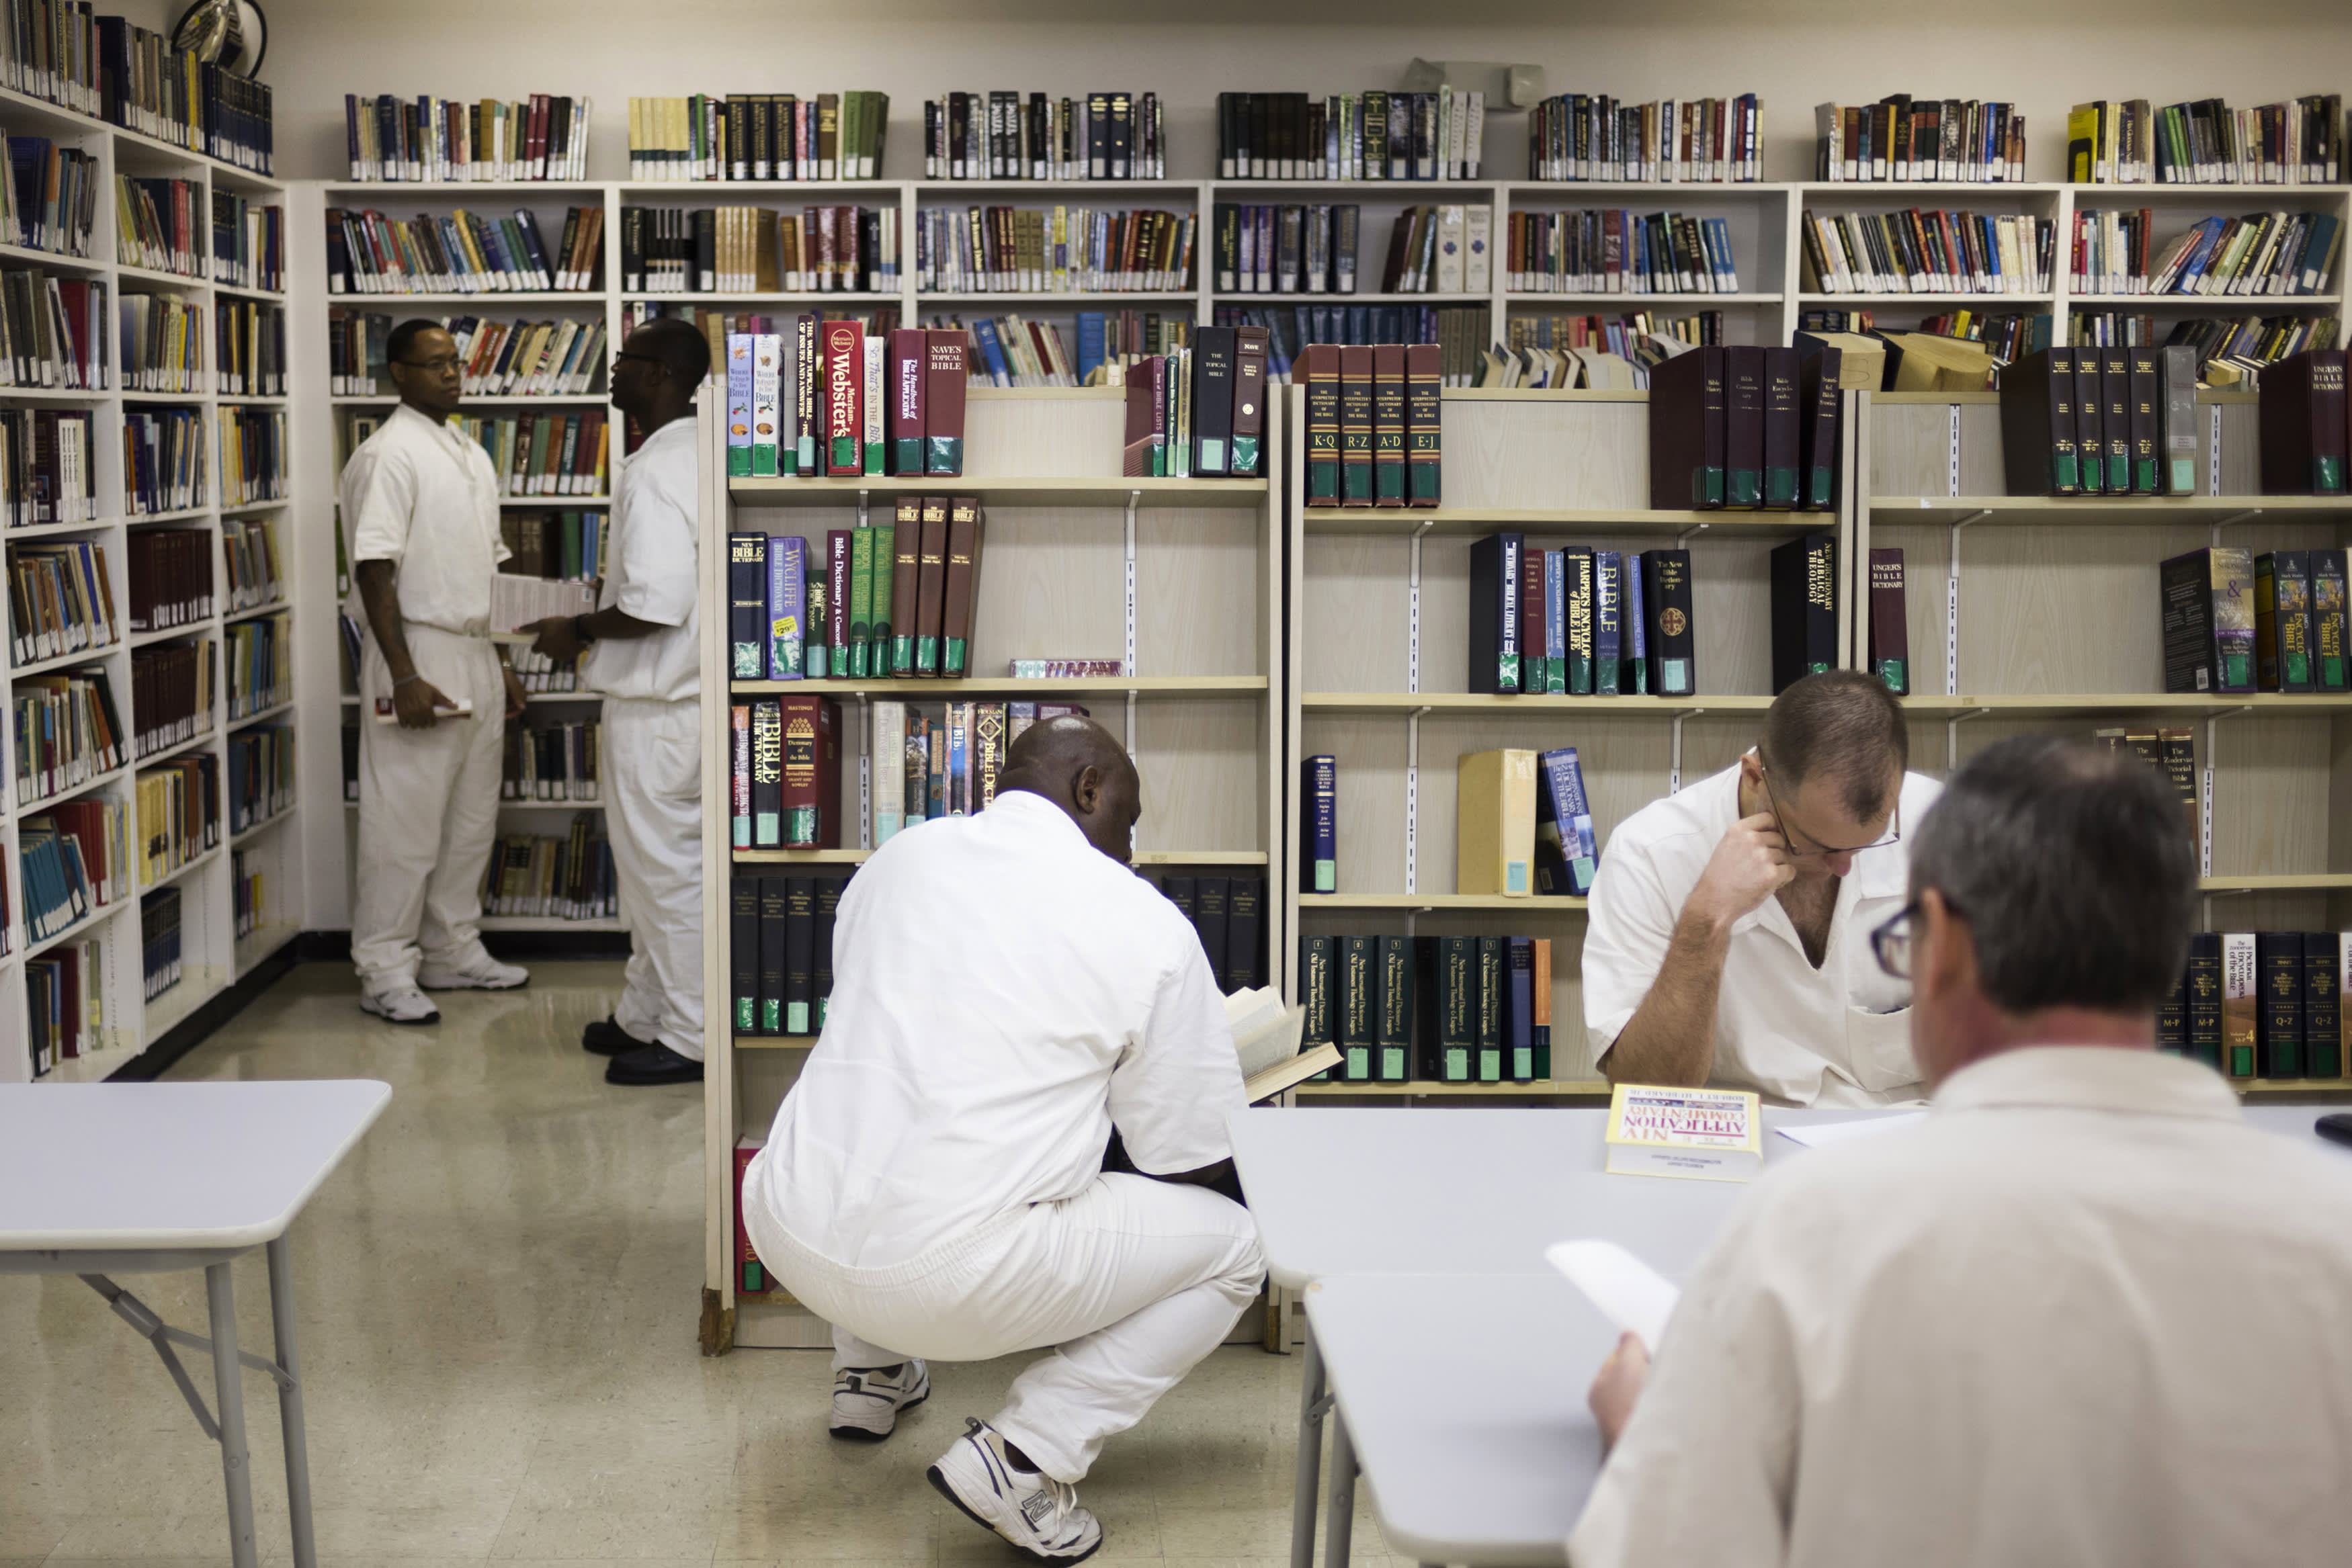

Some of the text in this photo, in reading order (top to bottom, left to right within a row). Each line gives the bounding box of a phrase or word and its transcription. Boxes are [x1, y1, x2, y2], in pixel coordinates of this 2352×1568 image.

[798, 322, 806, 333] OF
[931, 345, 962, 354] NAVE'S
[869, 362, 880, 393] That's
[931, 362, 962, 370] BIBLE
[2313, 365, 2343, 373] UNGER'S
[2314, 374, 2343, 382] BIBLE
[729, 387, 751, 398] BIBLE
[755, 392, 776, 402] BIBLE
[832, 353, 851, 437] Webster's
[870, 395, 877, 403] IN
[902, 359, 910, 419] BIBLE APPLICATION
[909, 359, 918, 420] The Handbook of
[732, 547, 764, 558] BIBLE
[853, 543, 862, 555] THE
[773, 543, 784, 614] BIBLE DICTIONARY
[784, 548, 800, 608] WYCLIFFE
[832, 537, 844, 618] Bible Dictionary &
[860, 531, 871, 615] THEOLOGICAL DICTIONARY
[1808, 550, 1817, 604] THEOLOGY
[1824, 543, 1833, 611] NEW DICTIONARY
[1872, 564, 1902, 572] UNGER'S
[1579, 560, 1591, 607] HARPER'S
[1816, 558, 1825, 605] BIBLICAL
[1872, 581, 1904, 589] DICTIONARY
[2227, 579, 2242, 599] &
[853, 574, 861, 615] TESTAMENT
[1600, 566, 1617, 634] BIBLE
[1570, 591, 1581, 650] of BIBLE LIFE
[2285, 623, 2296, 651] BIBLE
[2321, 623, 2332, 651] BIBLE
[753, 722, 763, 784] DICTIONARY
[763, 722, 781, 784] BIBLE
[984, 741, 996, 773] BIBLE
[1555, 773, 1563, 783] OF
[1562, 772, 1576, 813] DICTIONARY
[2163, 1018, 2181, 1027] M-P
[2198, 1018, 2215, 1027] M-P
[2275, 1016, 2293, 1027] Q-Z
[2315, 1016, 2333, 1027] Q-Z
[2246, 1029, 2255, 1043] 4
[1624, 1115, 1746, 1134] APPLICATION
[1627, 1105, 1745, 1121] COMMENTARY
[1623, 1127, 1669, 1141] NIV
[1021, 1489, 1054, 1523] N
